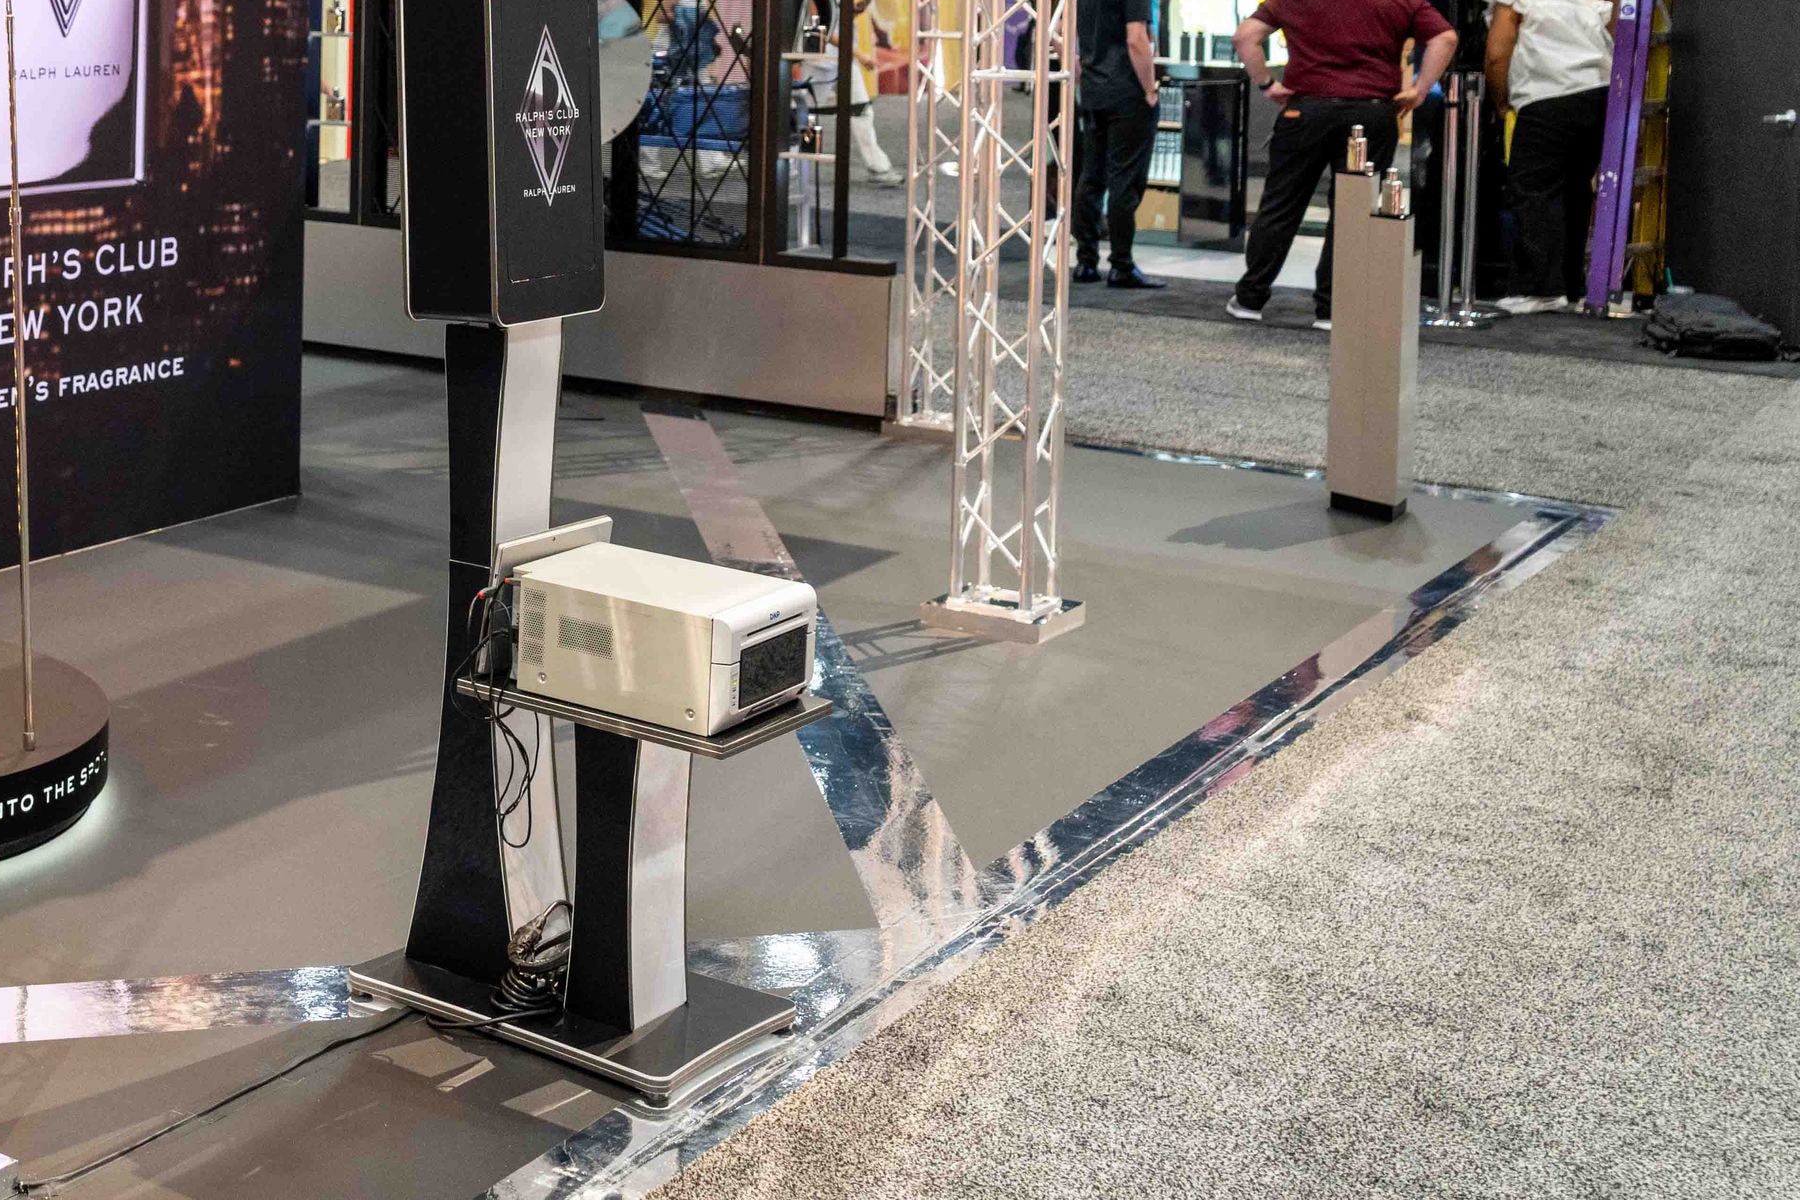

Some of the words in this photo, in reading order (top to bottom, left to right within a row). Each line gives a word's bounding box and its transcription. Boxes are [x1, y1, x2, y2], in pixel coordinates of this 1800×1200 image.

[13, 67, 57, 81] ALPH
[64, 64, 121, 79] LAUREN
[515, 110, 554, 123] RALPH'S
[556, 108, 580, 120] CLUB
[525, 127, 545, 139] NEW
[547, 125, 572, 137] YORK
[523, 187, 547, 198] RALPH
[95, 236, 178, 276] CLUB
[57, 293, 144, 335] YORK
[58, 356, 185, 398] FRAGRANCE
[43, 775, 75, 804] THE
